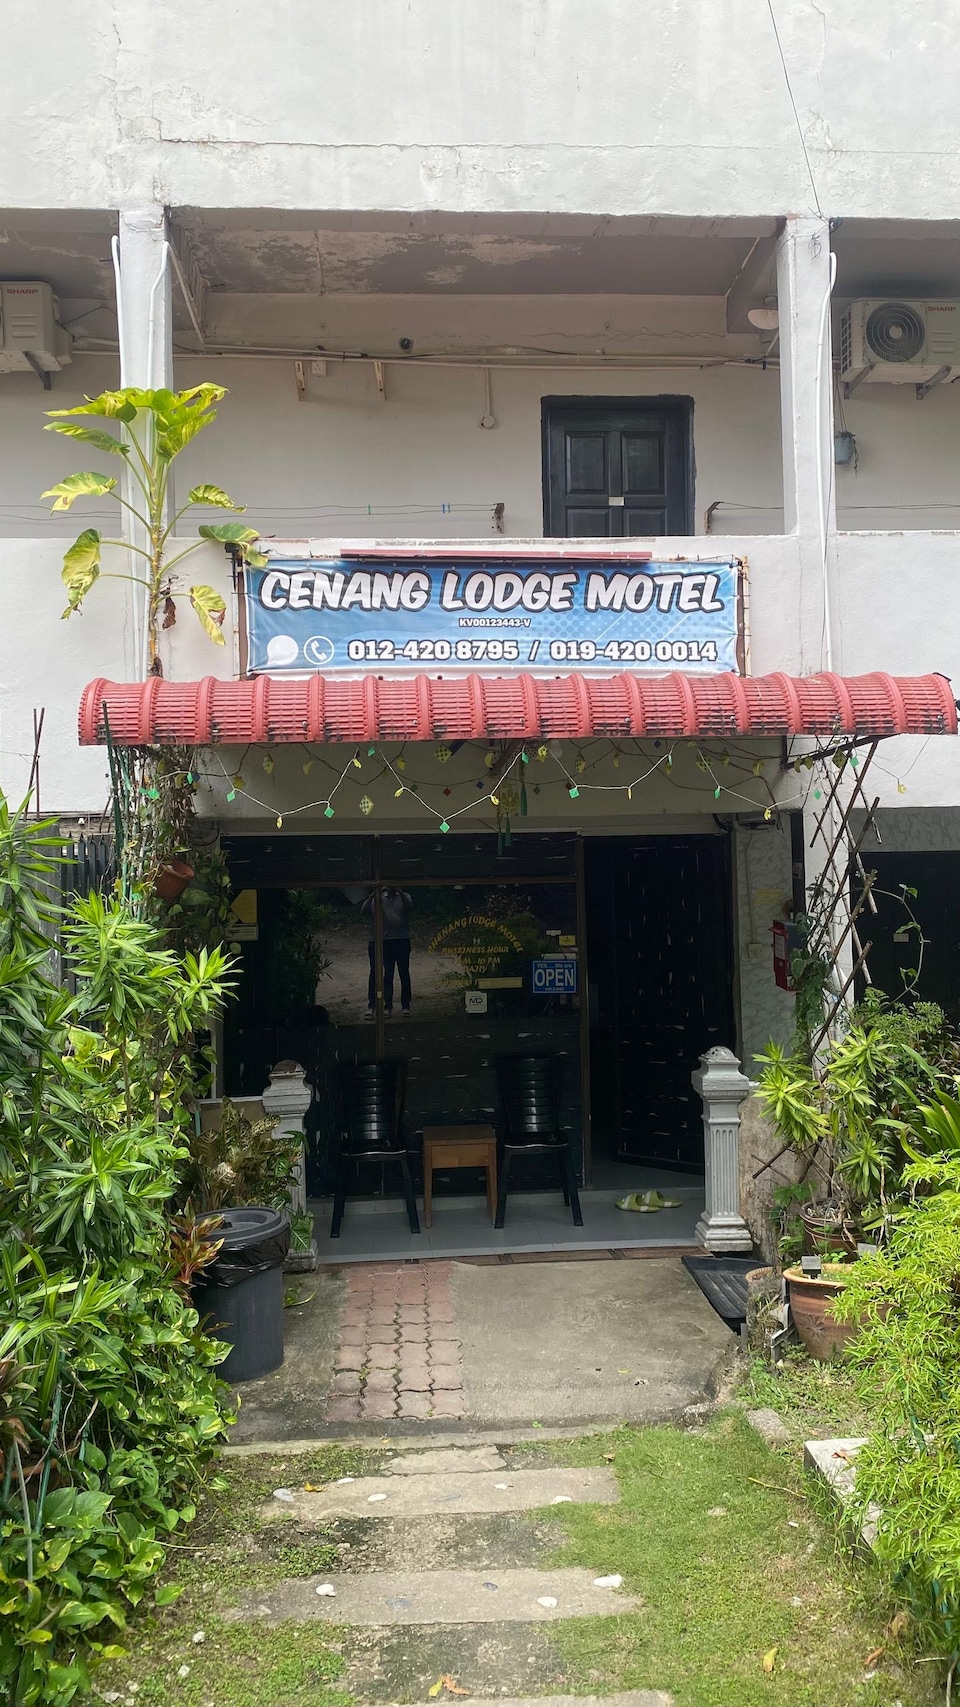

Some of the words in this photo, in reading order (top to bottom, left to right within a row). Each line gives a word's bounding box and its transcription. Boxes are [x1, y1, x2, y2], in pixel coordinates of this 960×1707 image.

[260, 569, 431, 612] CENANG
[440, 571, 579, 612] LODGE
[585, 572, 725, 613] MOTEL
[459, 618, 531, 627] KV00123443-V
[348, 639, 451, 661] 012-420
[455, 639, 519, 661] 8795
[528, 639, 540, 661] /
[549, 640, 651, 662] 019-420
[655, 640, 717, 662] 0014
[534, 968, 574, 987] OPEN
